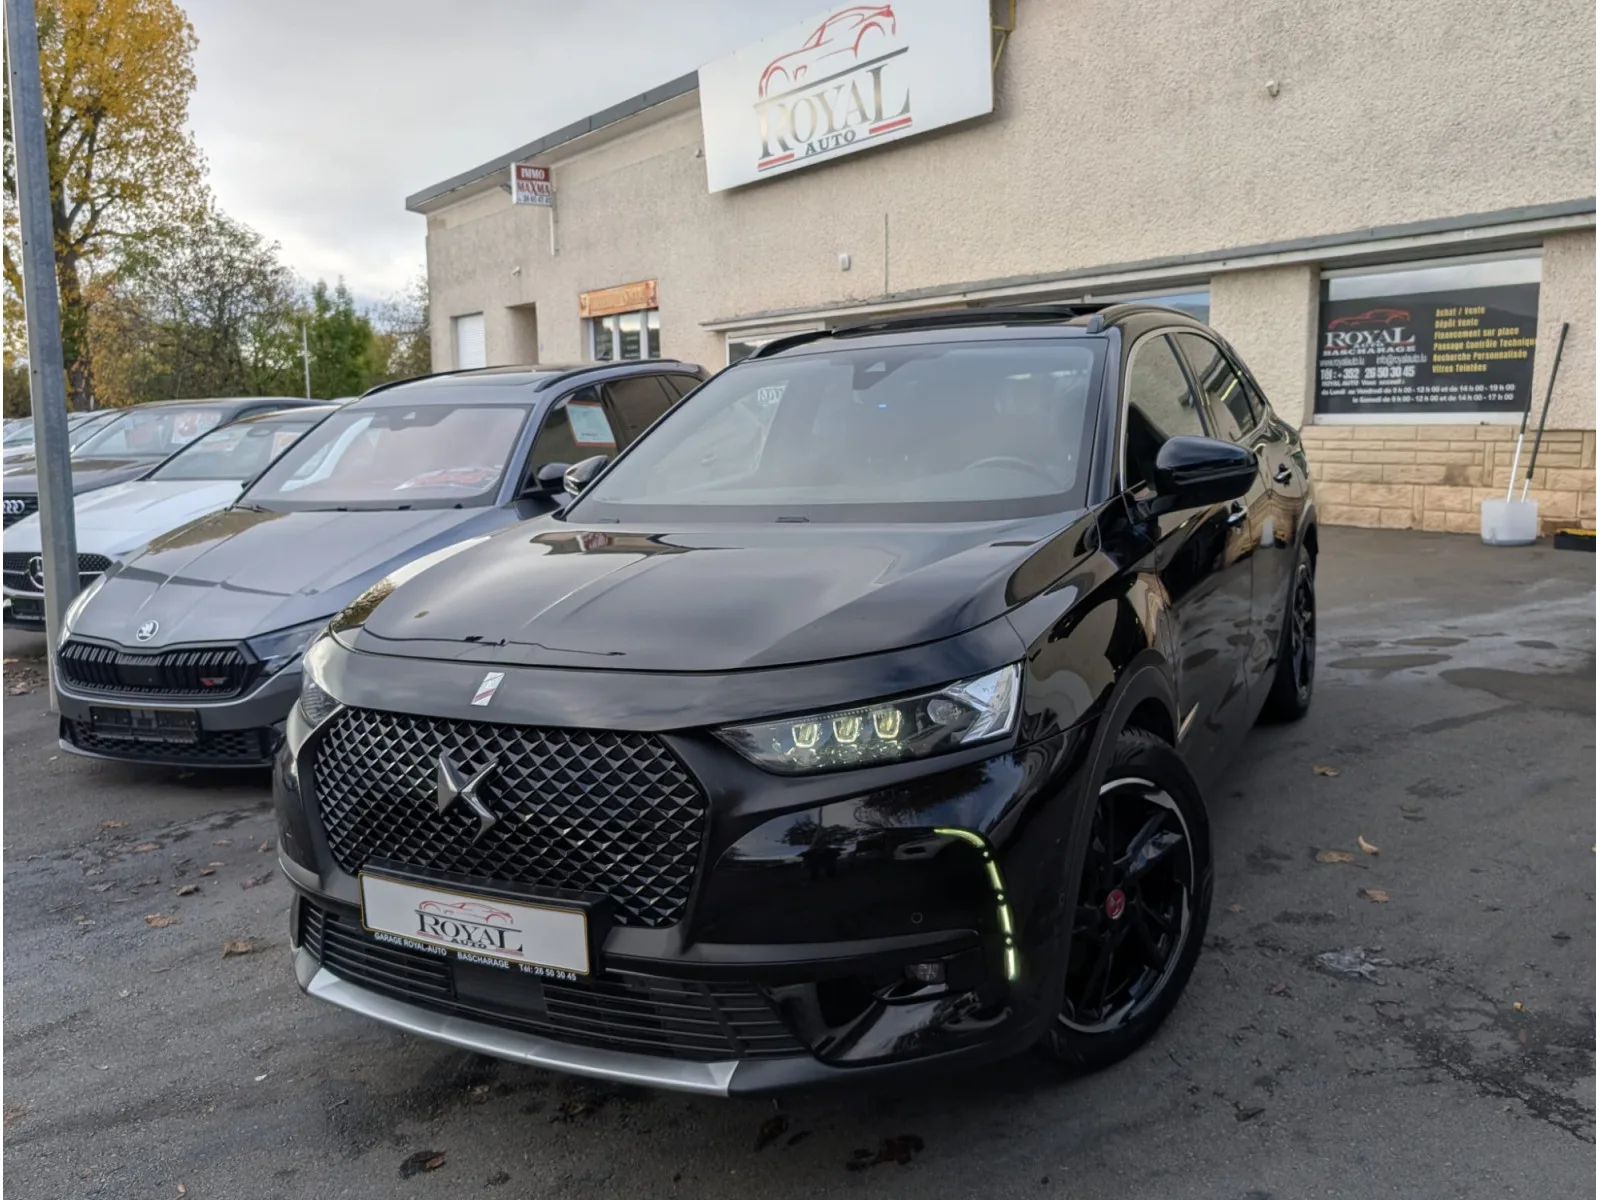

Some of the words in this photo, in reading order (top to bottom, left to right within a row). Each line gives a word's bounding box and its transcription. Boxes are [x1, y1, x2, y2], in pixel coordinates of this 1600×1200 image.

[753, 64, 911, 160] ROYAL
[805, 130, 856, 155] AUTO
[521, 167, 545, 180] IMMO
[1436, 307, 1457, 317] Achat
[1464, 306, 1485, 315] Vente
[1325, 327, 1416, 347] ROYAL
[1434, 329, 1481, 340] Financement
[1482, 328, 1495, 337] sur
[1497, 327, 1519, 337] place
[1323, 345, 1416, 356] BASCHARAGE
[1433, 341, 1464, 351] Passage
[1465, 339, 1497, 349] Contrôle
[1432, 353, 1471, 362] Recherche
[1343, 367, 1360, 380] 352
[1364, 367, 1376, 379] 26
[1377, 366, 1389, 378] 50
[1390, 366, 1402, 378] 30
[1402, 365, 1416, 377] 45
[1432, 364, 1454, 373] Vitres
[1505, 383, 1515, 391] 00
[418, 913, 523, 952] ROYAL
[451, 938, 487, 950] AUTO
[374, 932, 403, 946] GARAGE
[403, 939, 447, 956] ROYAL-AUTO
[457, 951, 510, 969] BASCHARAGE
[519, 963, 533, 974] Tél:
[534, 966, 544, 975] 26
[545, 968, 554, 977] 50
[556, 970, 566, 979] 30
[567, 972, 577, 981] 45
